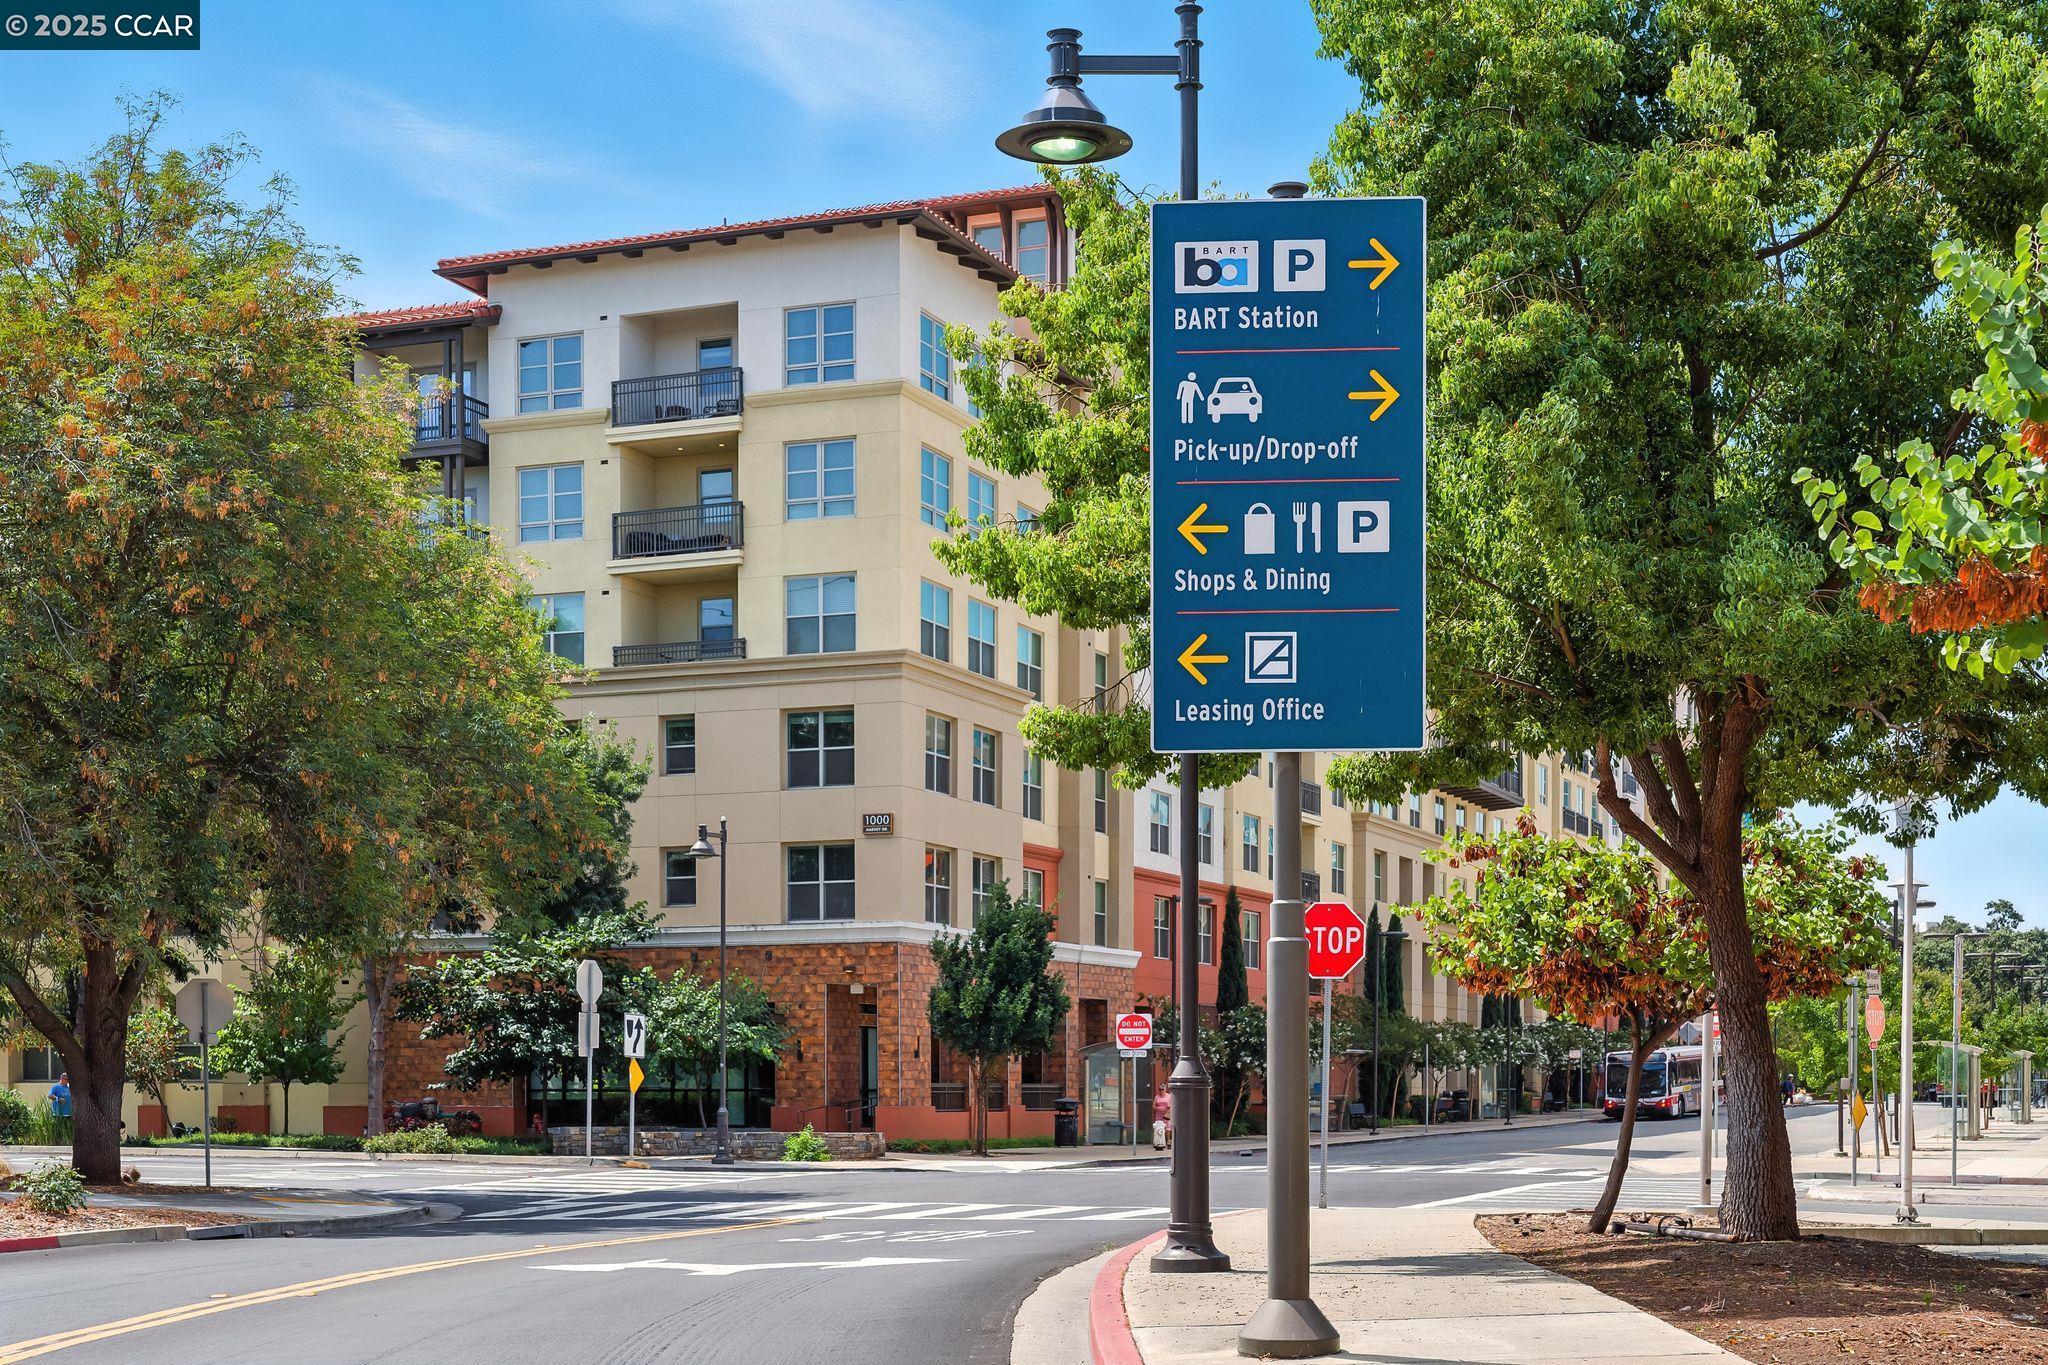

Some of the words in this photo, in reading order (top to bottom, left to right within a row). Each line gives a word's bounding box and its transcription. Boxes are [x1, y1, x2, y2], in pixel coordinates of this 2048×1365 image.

[1202, 246, 1249, 255] BART
[1288, 249, 1315, 282] P
[1174, 307, 1230, 330] BART
[1238, 305, 1318, 329] Station
[1174, 435, 1359, 465] Pick-up/Drop-off
[1352, 510, 1379, 544] P
[1174, 568, 1236, 596] Shops
[1243, 568, 1258, 591] &
[1266, 567, 1331, 595] Dining
[1175, 699, 1254, 726] Leasing
[1262, 698, 1325, 721] Office
[865, 815, 890, 825] 1000
[1866, 1009, 1885, 1026] STOP
